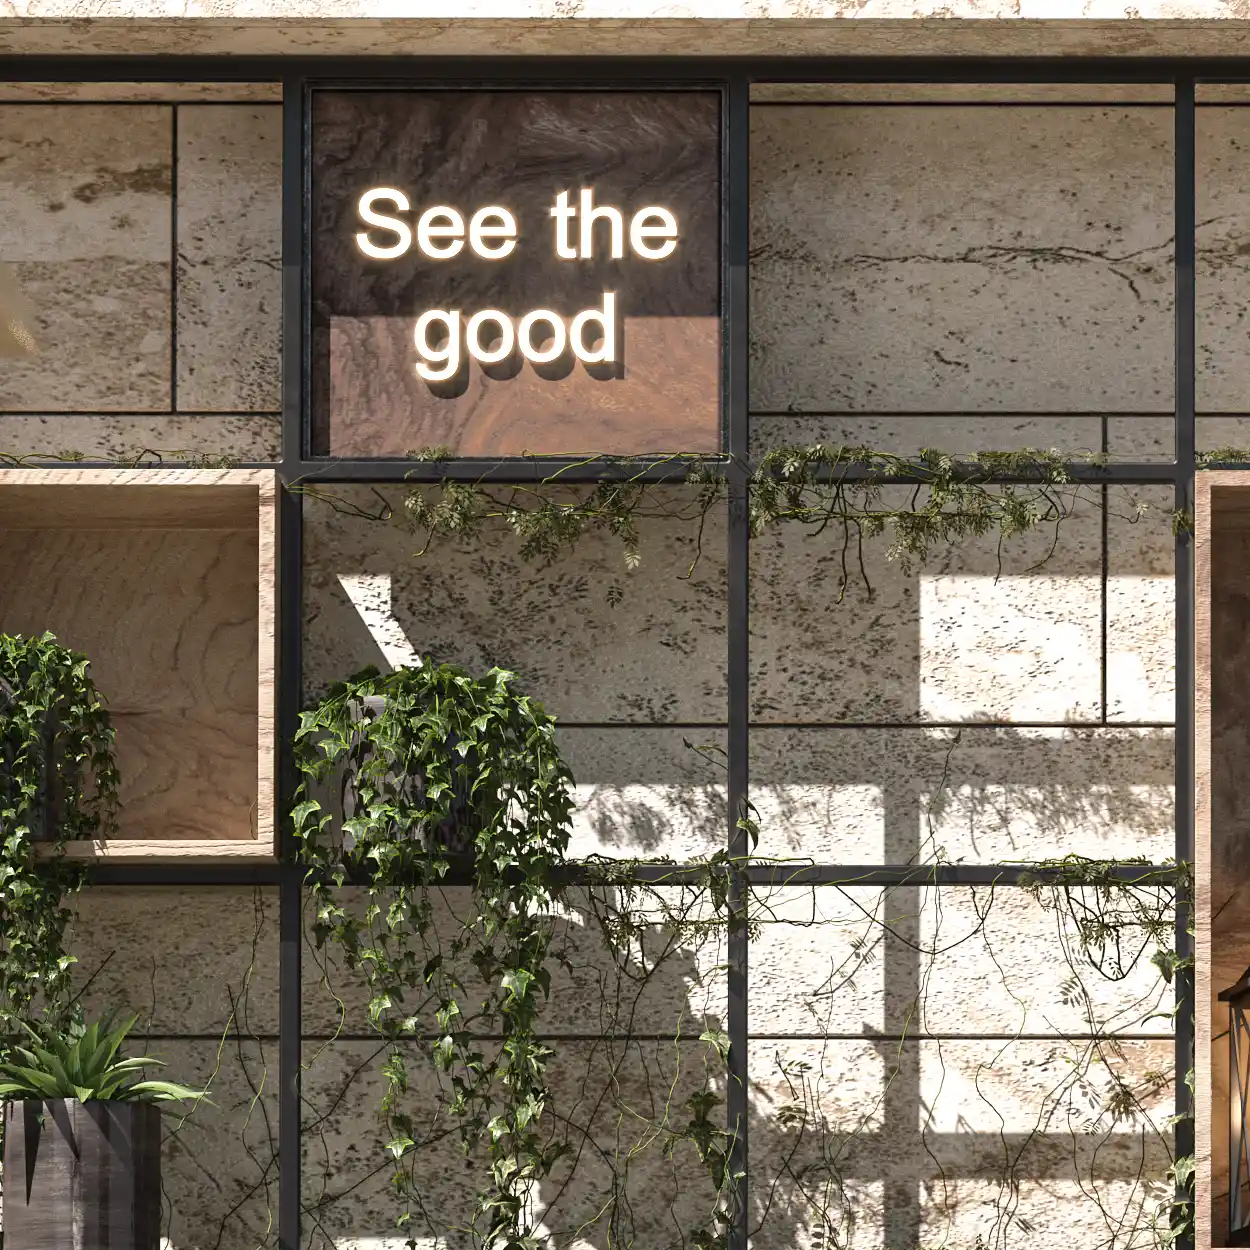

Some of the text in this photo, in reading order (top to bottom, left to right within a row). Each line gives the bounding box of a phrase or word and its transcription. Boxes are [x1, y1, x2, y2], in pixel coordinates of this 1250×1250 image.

[354, 186, 680, 261] See the
[411, 291, 617, 382] good
